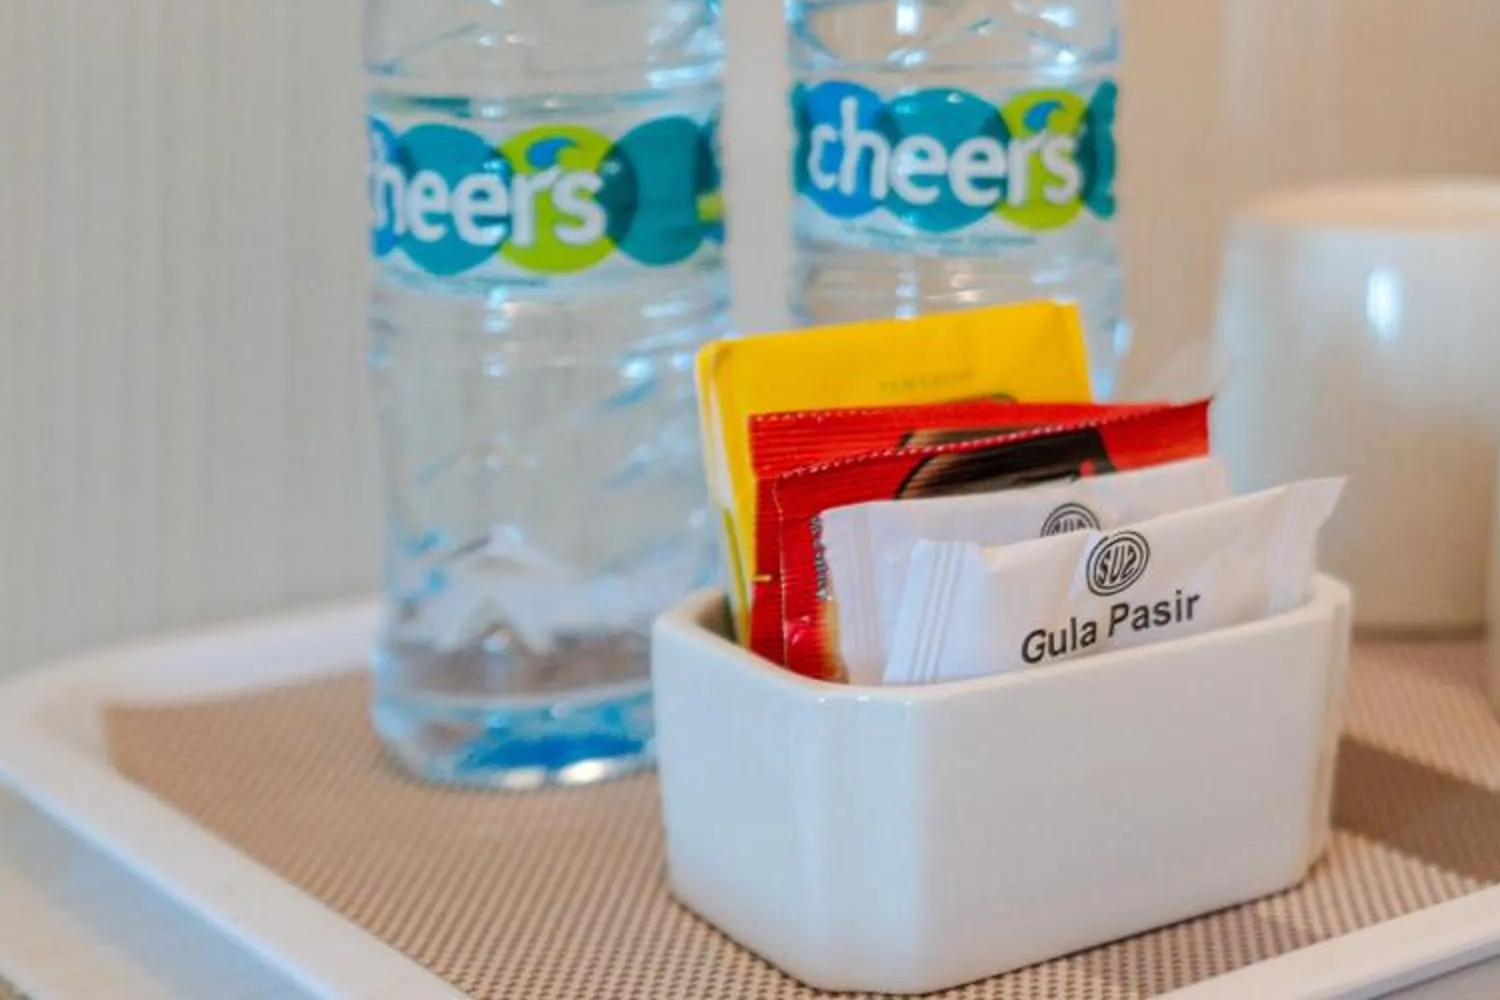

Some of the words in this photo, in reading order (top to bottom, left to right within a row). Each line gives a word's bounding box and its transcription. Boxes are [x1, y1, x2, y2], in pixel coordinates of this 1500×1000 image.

[370, 130, 608, 247] heers
[807, 96, 1084, 207] cheers
[1021, 616, 1097, 664] Gula
[1107, 589, 1201, 638] Pasir
